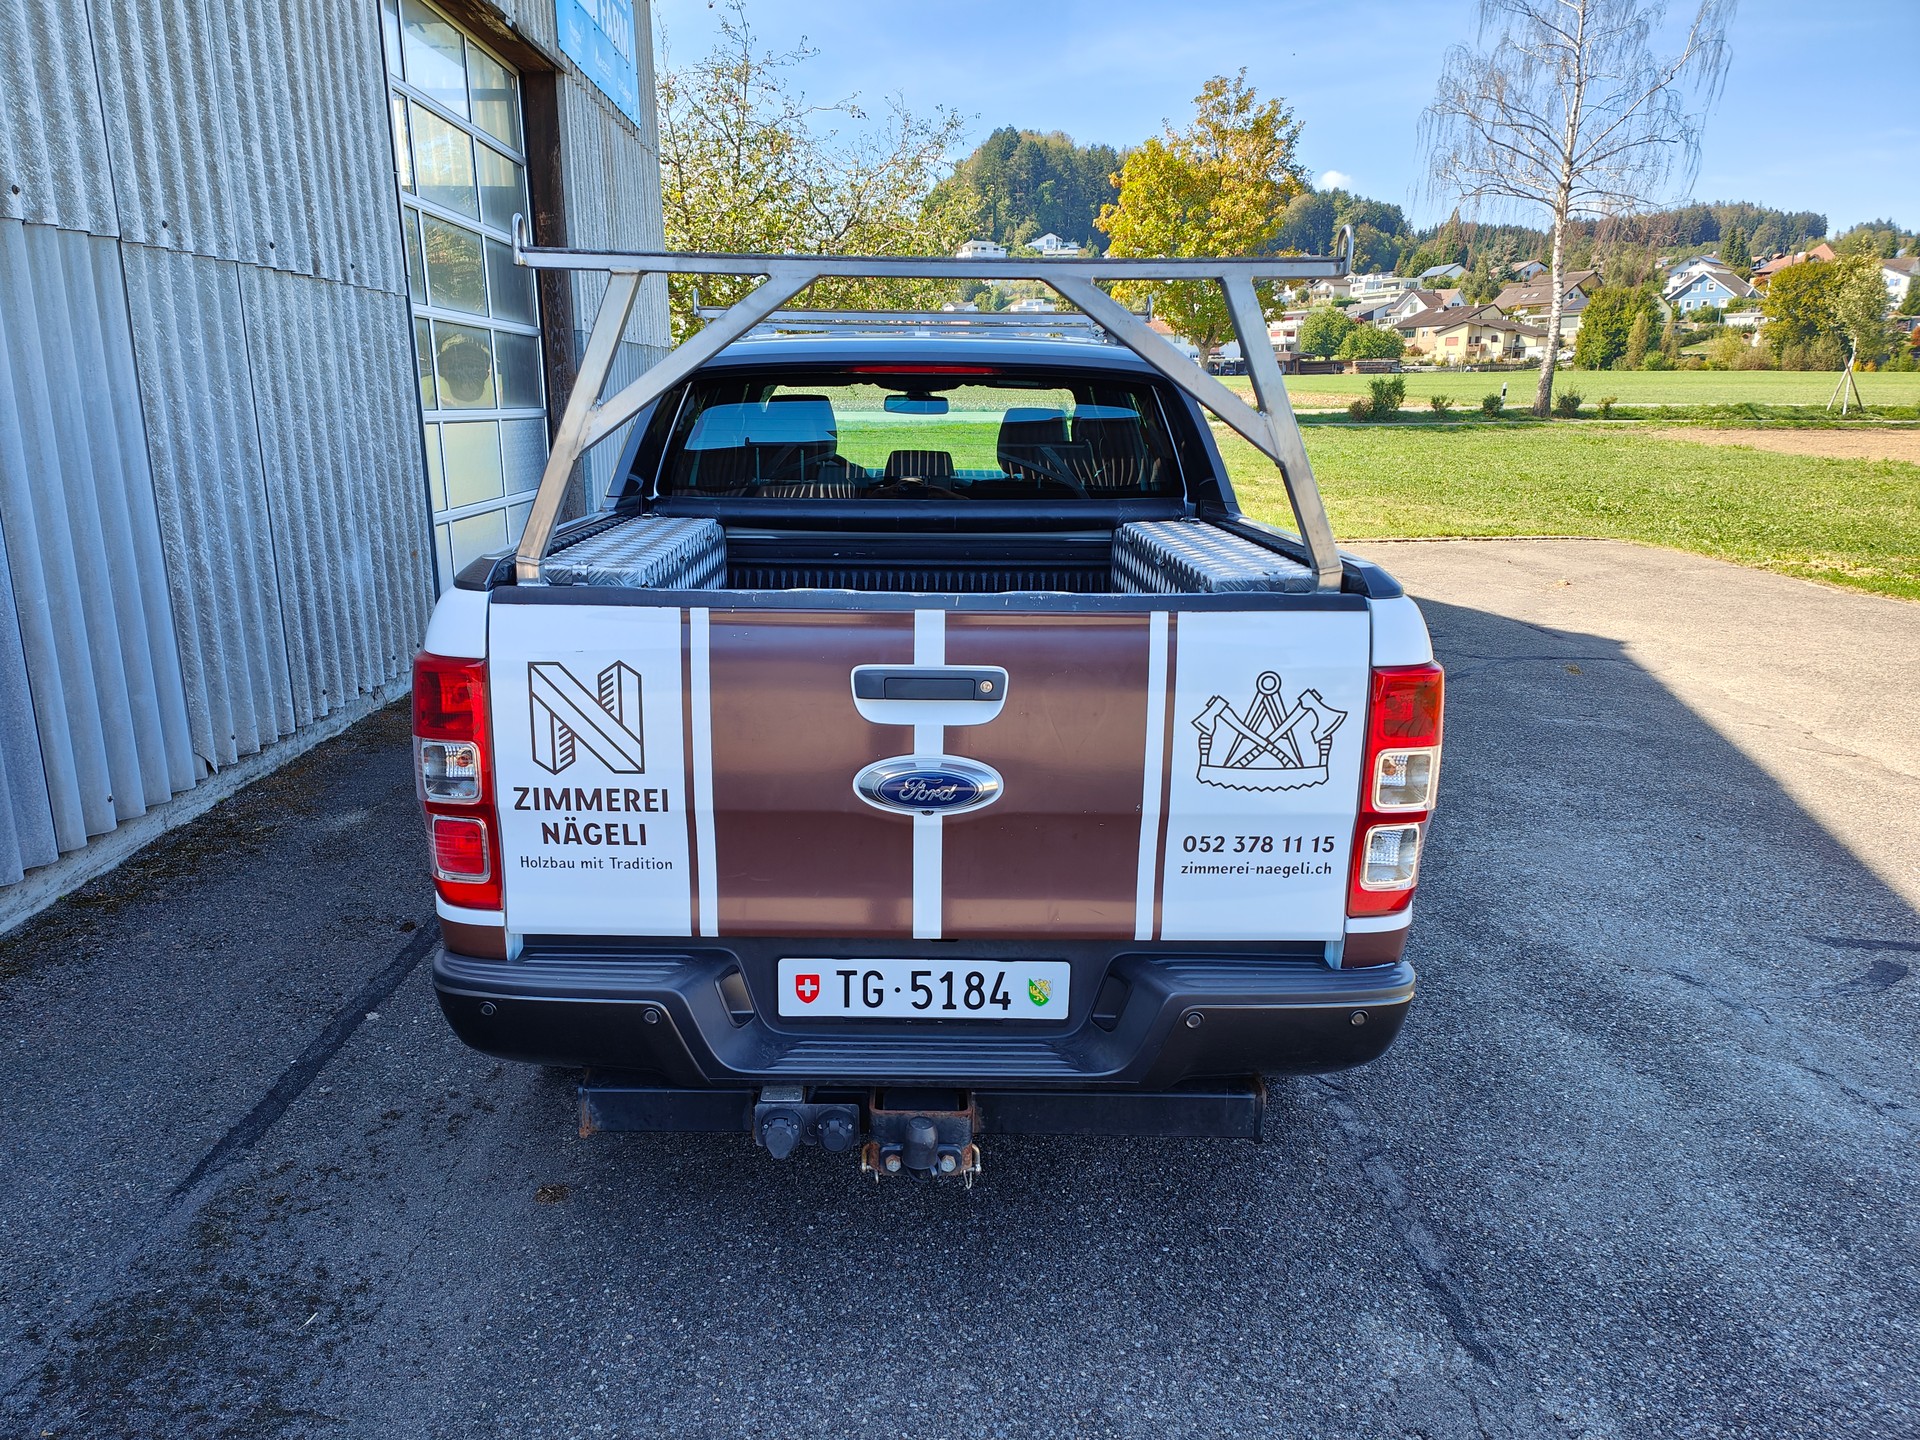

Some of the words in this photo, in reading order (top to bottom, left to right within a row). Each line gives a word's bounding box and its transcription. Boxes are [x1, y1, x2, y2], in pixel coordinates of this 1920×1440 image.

[899, 777, 957, 801] Ford
[513, 787, 669, 812] ZIMMEREI
[541, 816, 647, 846] NÄGELI
[1182, 836, 1225, 853] 052
[1233, 836, 1274, 853] 378
[1282, 836, 1301, 853] 11
[1311, 836, 1335, 853] 15
[520, 856, 575, 869] Holzbau
[580, 857, 603, 869] mit
[609, 857, 673, 870] Tradition
[1181, 861, 1332, 878] zimmerei-naegeli.ch
